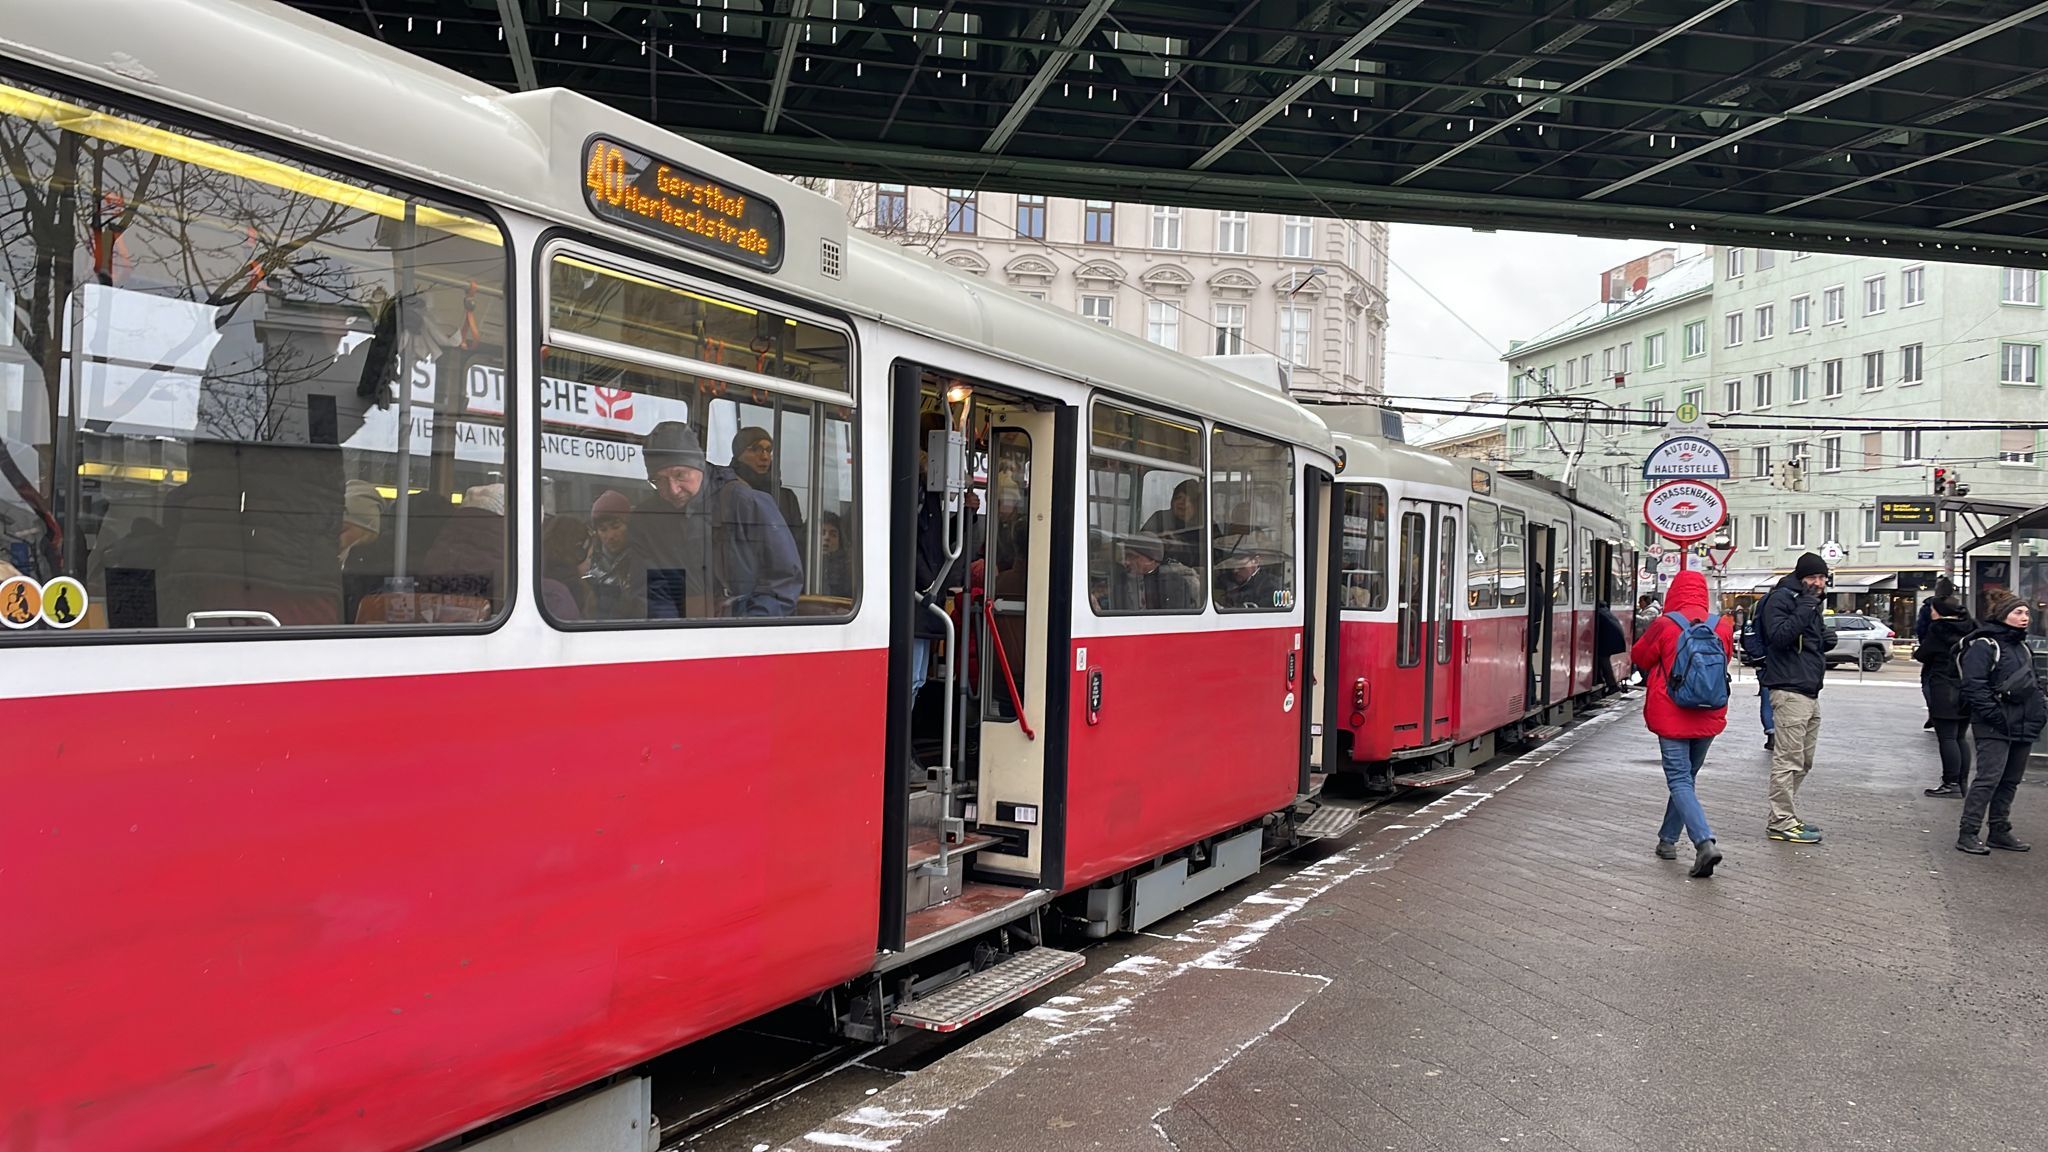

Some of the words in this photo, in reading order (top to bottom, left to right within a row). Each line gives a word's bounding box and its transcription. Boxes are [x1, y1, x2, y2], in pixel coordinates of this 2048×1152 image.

[586, 142, 624, 206] 40
[656, 165, 745, 219] Gersthof
[625, 185, 769, 256] Herbeckstraße
[1682, 407, 1693, 419] H
[585, 441, 636, 463] GROUP
[1664, 442, 1711, 457] AUTOBUS
[1654, 464, 1718, 474] HALTESTELLE
[1653, 486, 1718, 507] STRASSENBAHN
[1655, 514, 1714, 533] HALTESTELLE
[1664, 555, 1676, 563] 41
[1698, 548, 1707, 557] N
